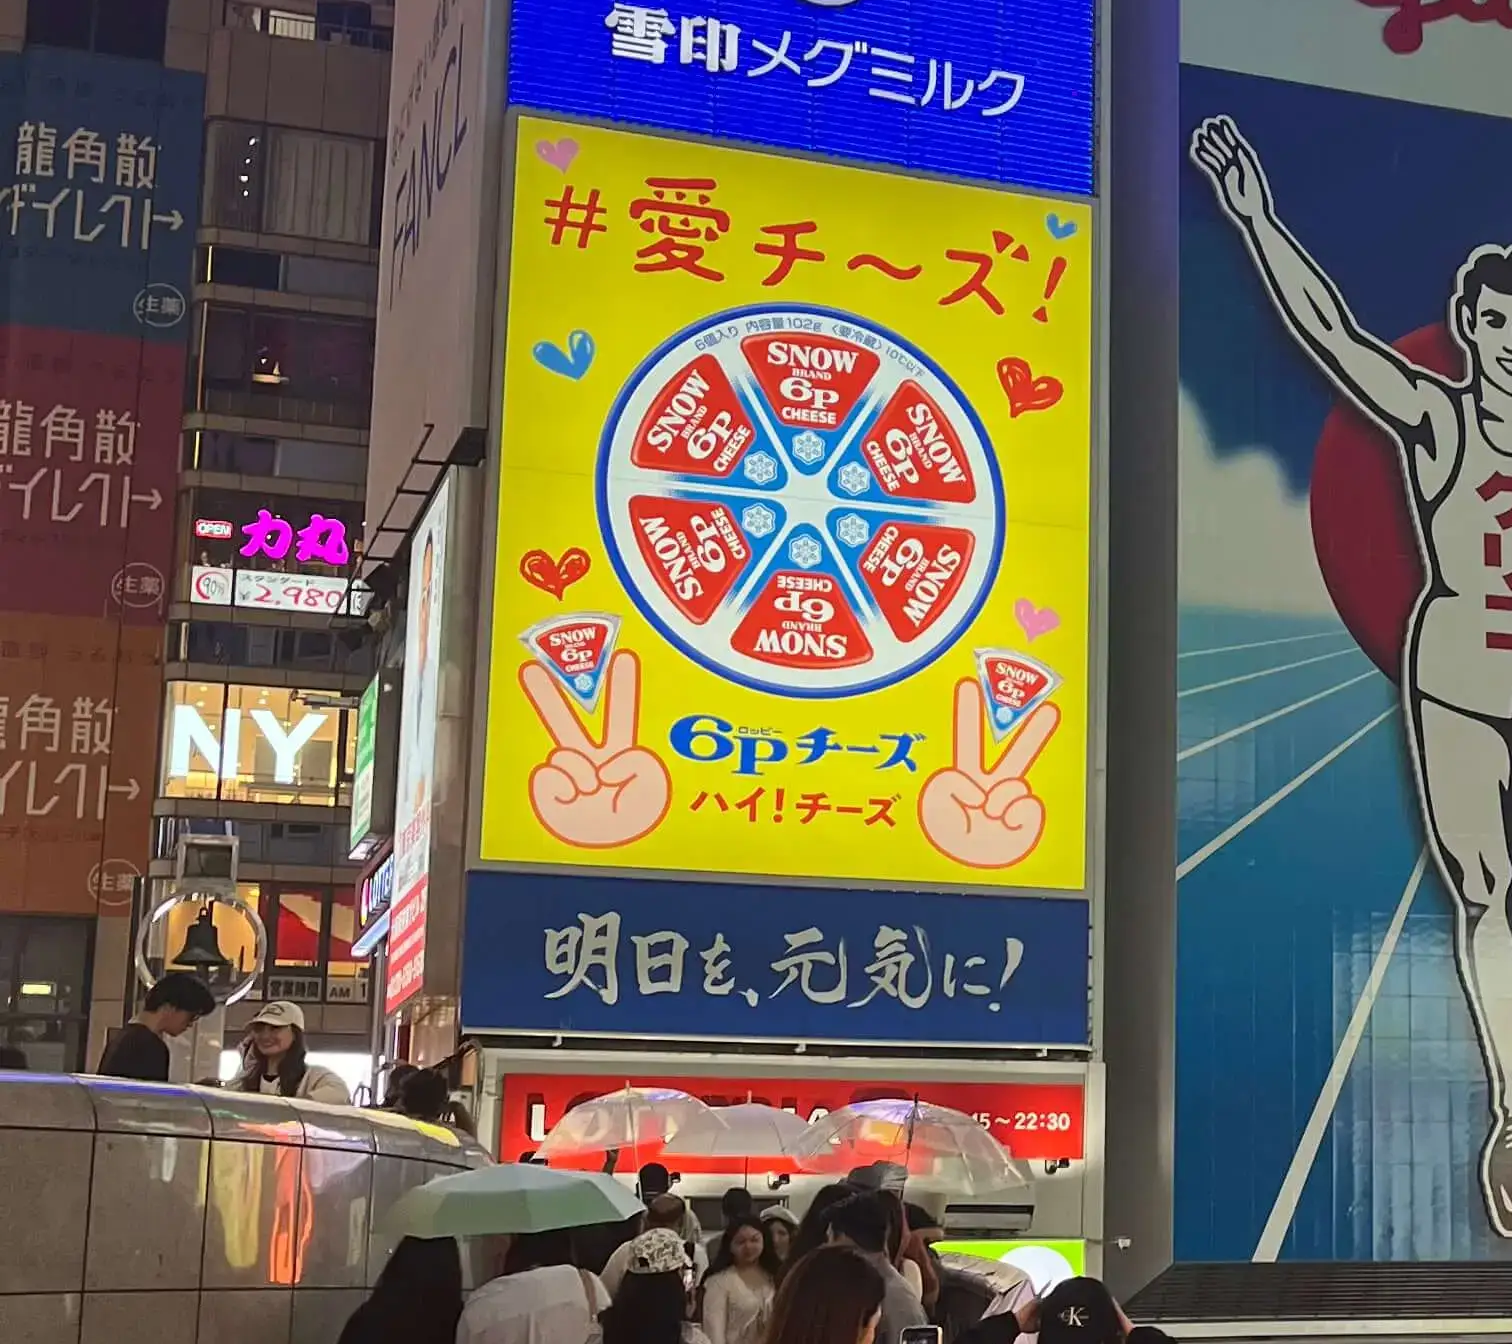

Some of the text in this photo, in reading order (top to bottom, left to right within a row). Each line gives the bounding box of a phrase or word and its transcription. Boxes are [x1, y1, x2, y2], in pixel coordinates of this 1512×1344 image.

[604, 2, 1025, 118] 雪印メグミルク
[16, 121, 161, 189] 龍角散
[768, 341, 859, 374] SNOW
[792, 368, 832, 381] BRAND
[647, 369, 710, 454] SNOW
[781, 406, 837, 425] CHEESE
[713, 424, 751, 472] CHEESE
[866, 440, 901, 492] CHEESE
[905, 403, 967, 483] SNOW
[239, 509, 349, 565] 力丸
[639, 517, 704, 600] SNOW
[710, 507, 746, 560] CHEESE
[862, 526, 899, 574] CHEESE
[777, 575, 833, 592] CHEESE
[902, 544, 961, 628] SNOW
[549, 626, 596, 647] SNOW
[753, 628, 848, 659] SNOW
[995, 661, 1039, 685] SNOW
[169, 705, 329, 783] NY
[543, 910, 1024, 1013] 明日を、元気に!
[329, 987, 350, 997] AM
